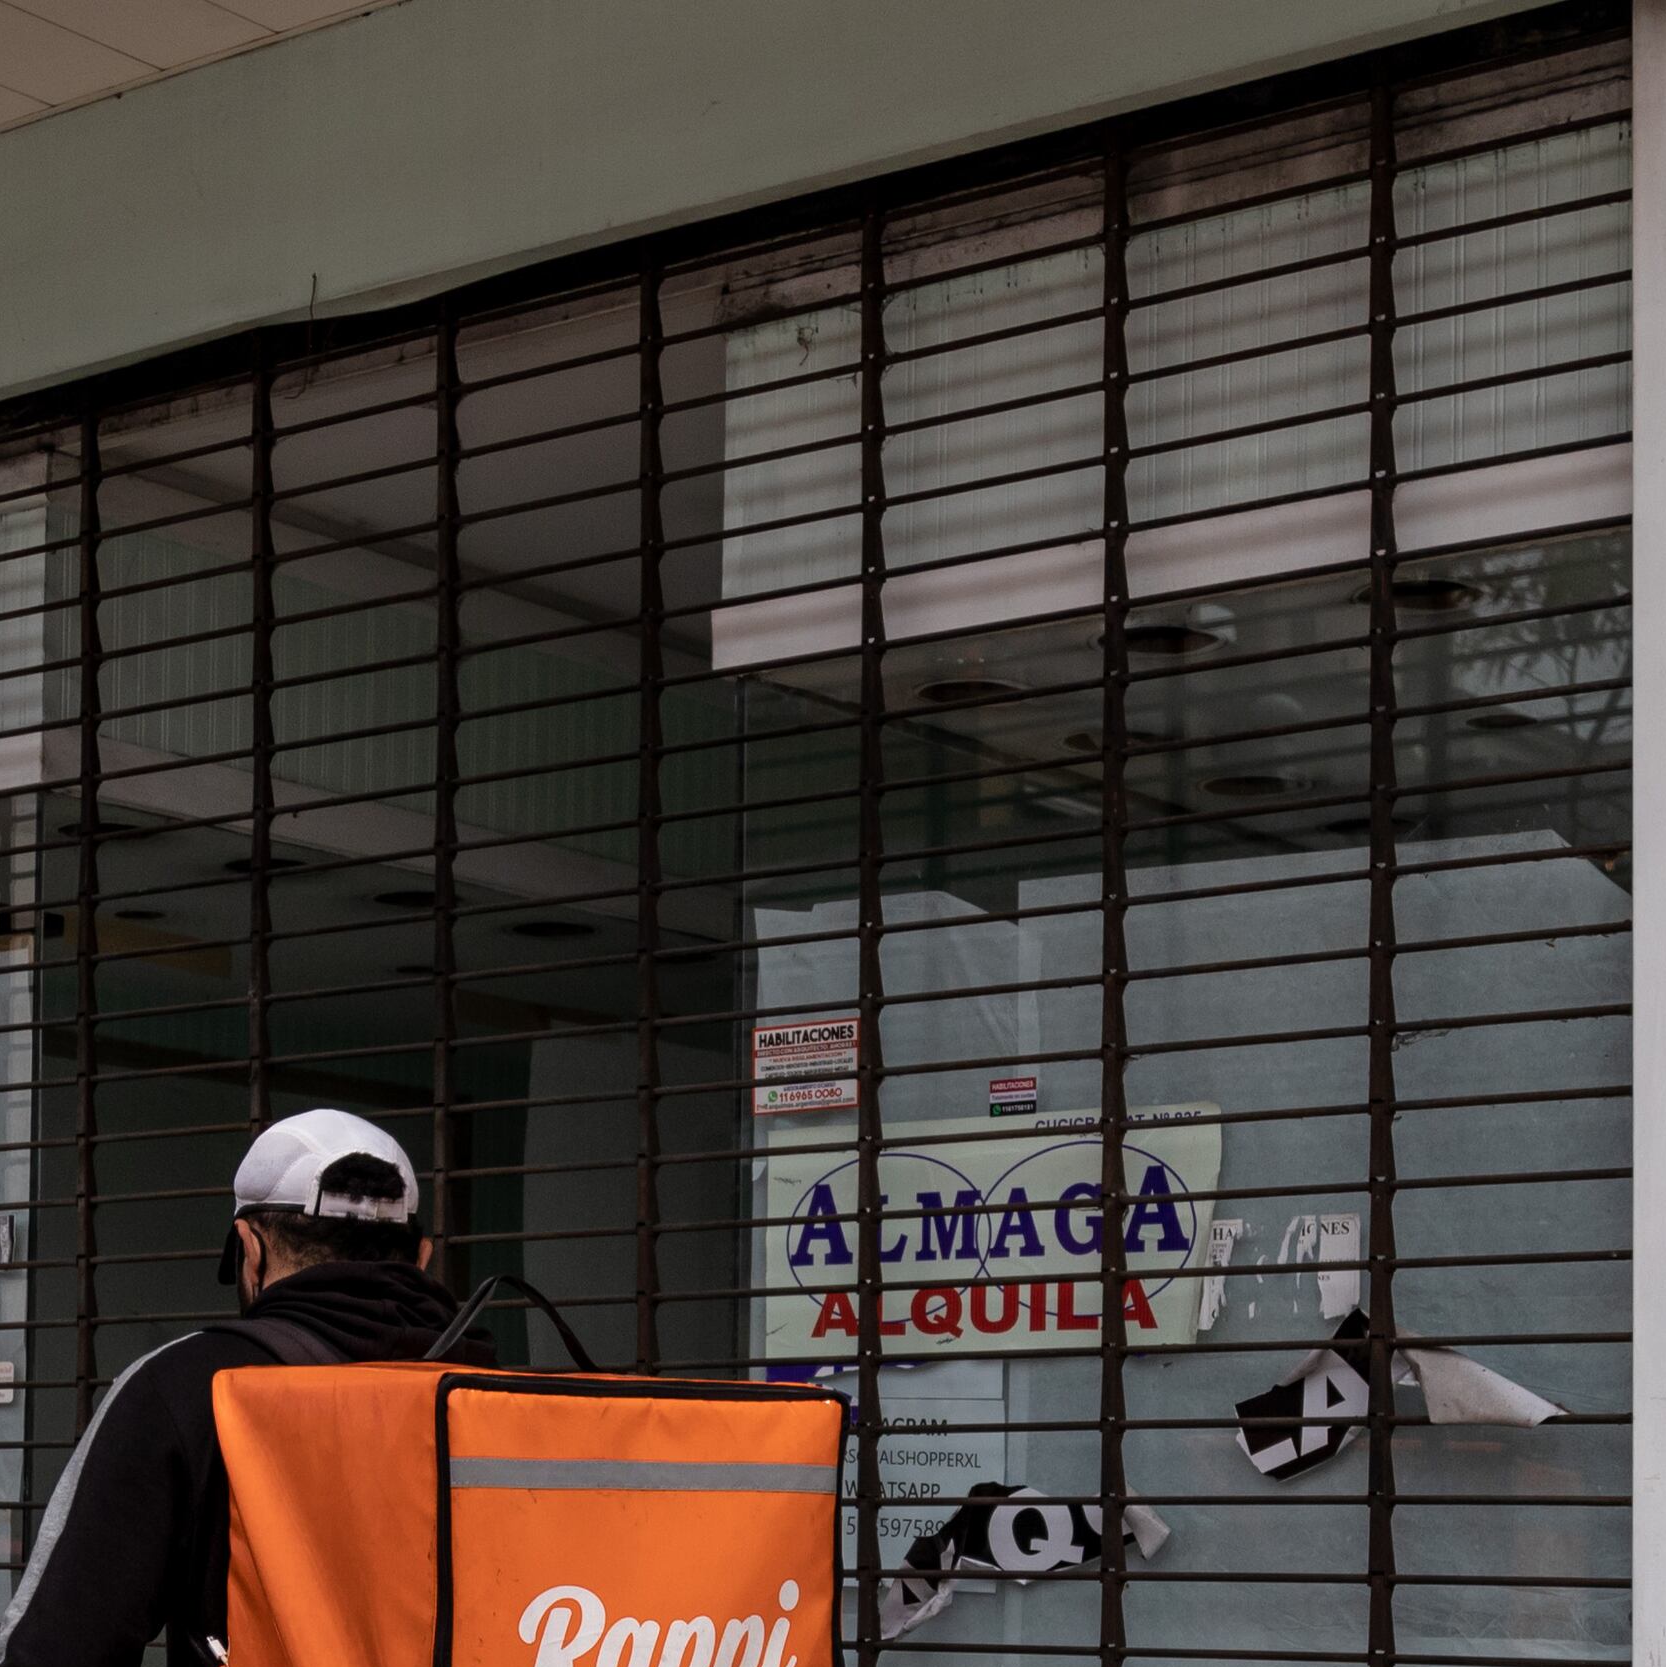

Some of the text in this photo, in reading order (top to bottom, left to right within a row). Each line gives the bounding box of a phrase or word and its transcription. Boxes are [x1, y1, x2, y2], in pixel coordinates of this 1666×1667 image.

[758, 1024, 854, 1048] HABILITACIONES
[790, 1165, 1191, 1267] ALMAGA
[811, 1279, 1159, 1338] ALQUILA
